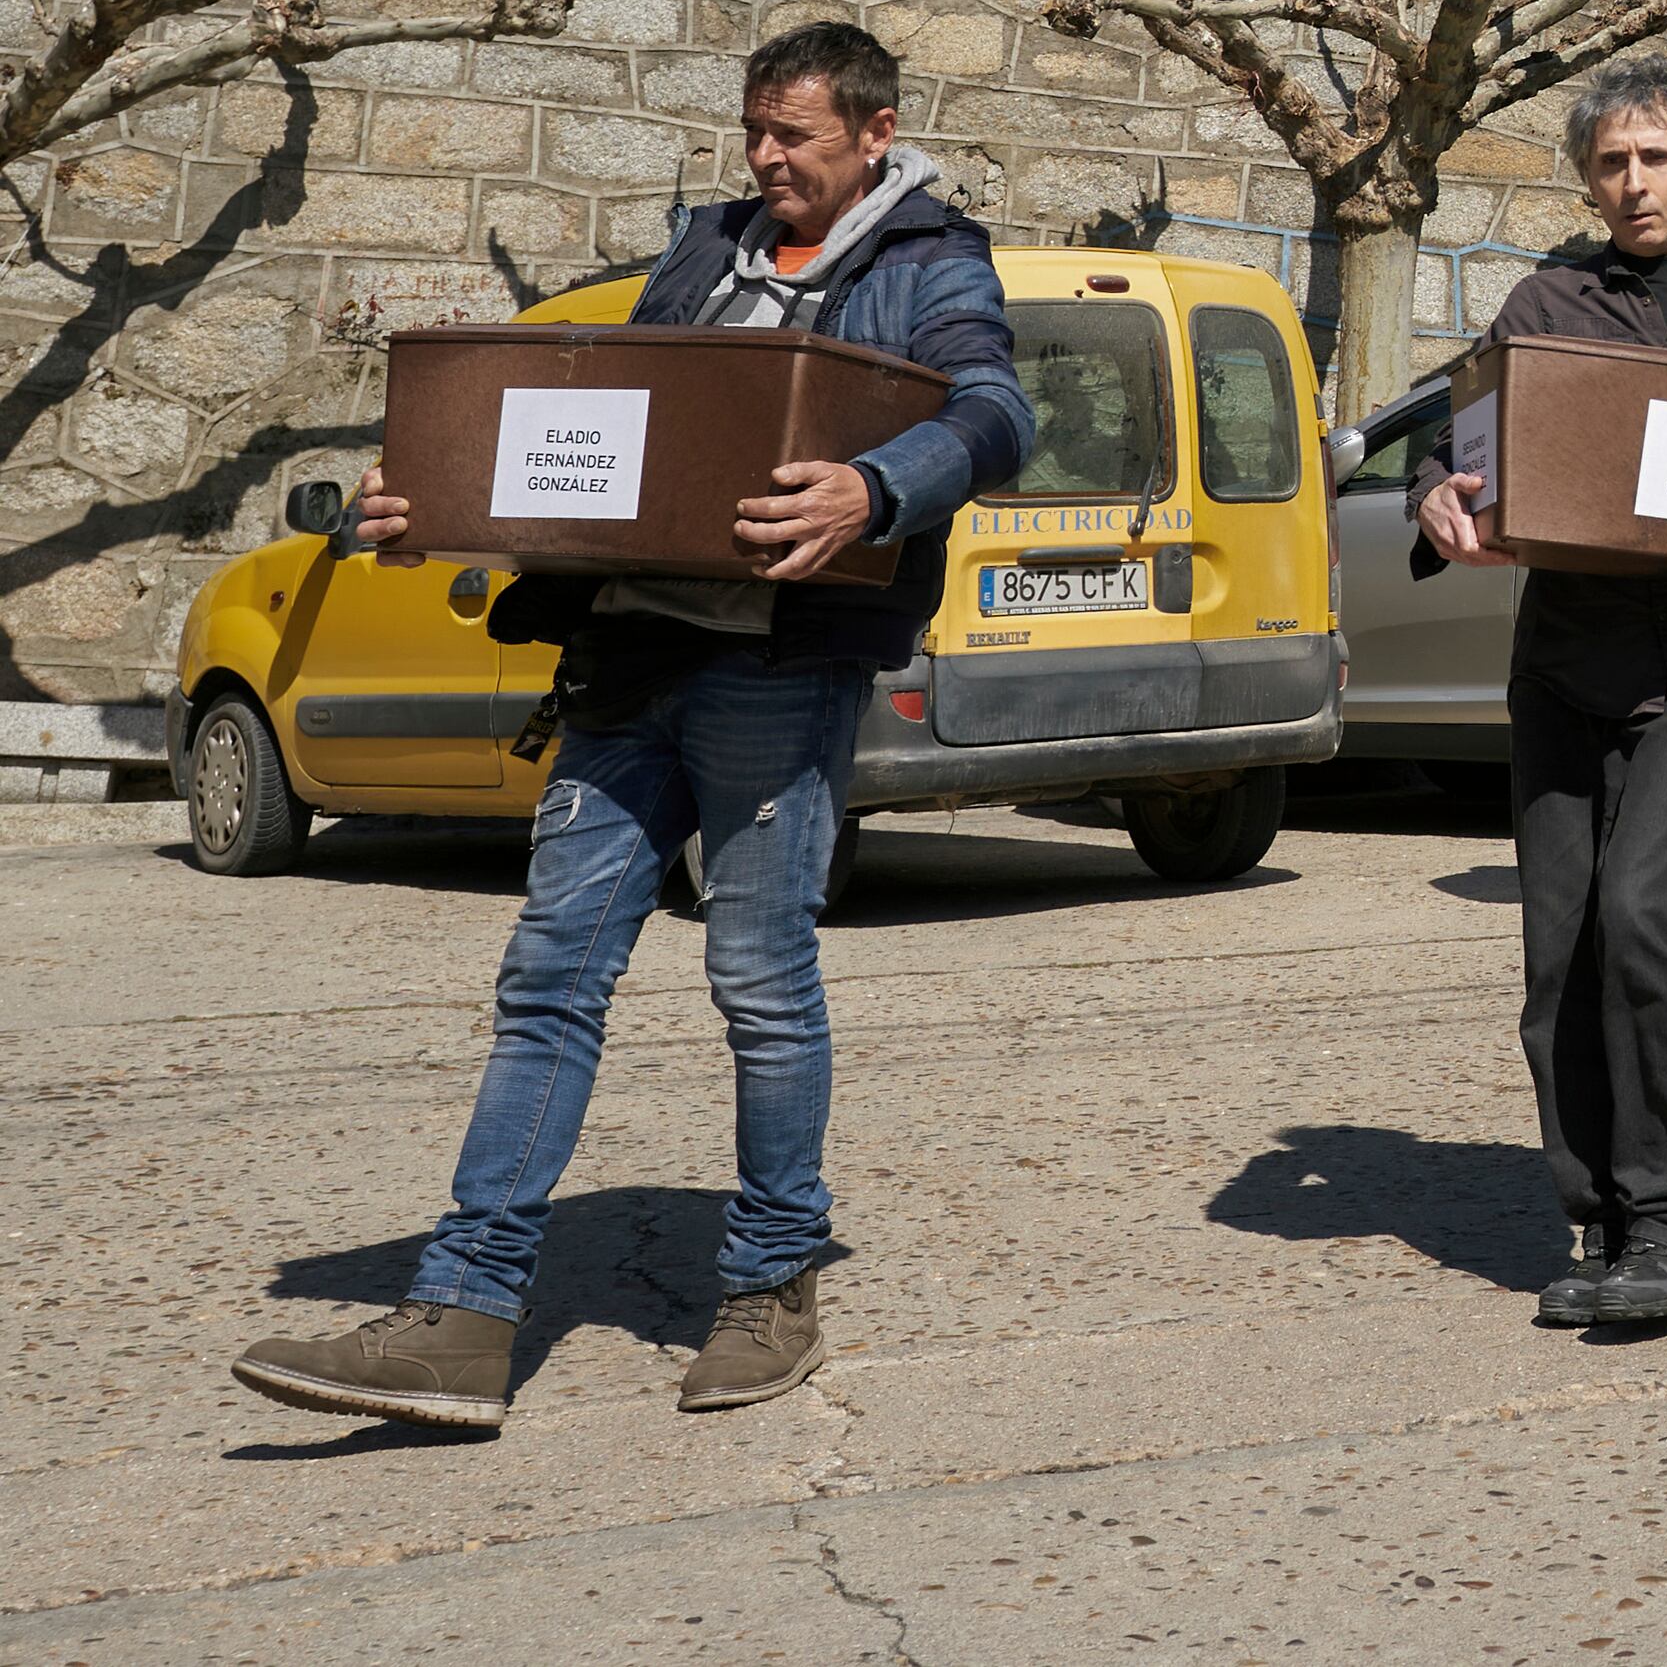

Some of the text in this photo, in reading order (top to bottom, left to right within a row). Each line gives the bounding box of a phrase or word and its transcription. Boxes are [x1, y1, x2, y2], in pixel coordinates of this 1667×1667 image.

[546, 429, 601, 445] ELADIO
[525, 451, 617, 469] FERNÁNDEZ
[527, 474, 609, 493] GONZÁLEZ
[1002, 567, 1139, 602] 8675 CFK
[966, 631, 1031, 648] RENAULT
